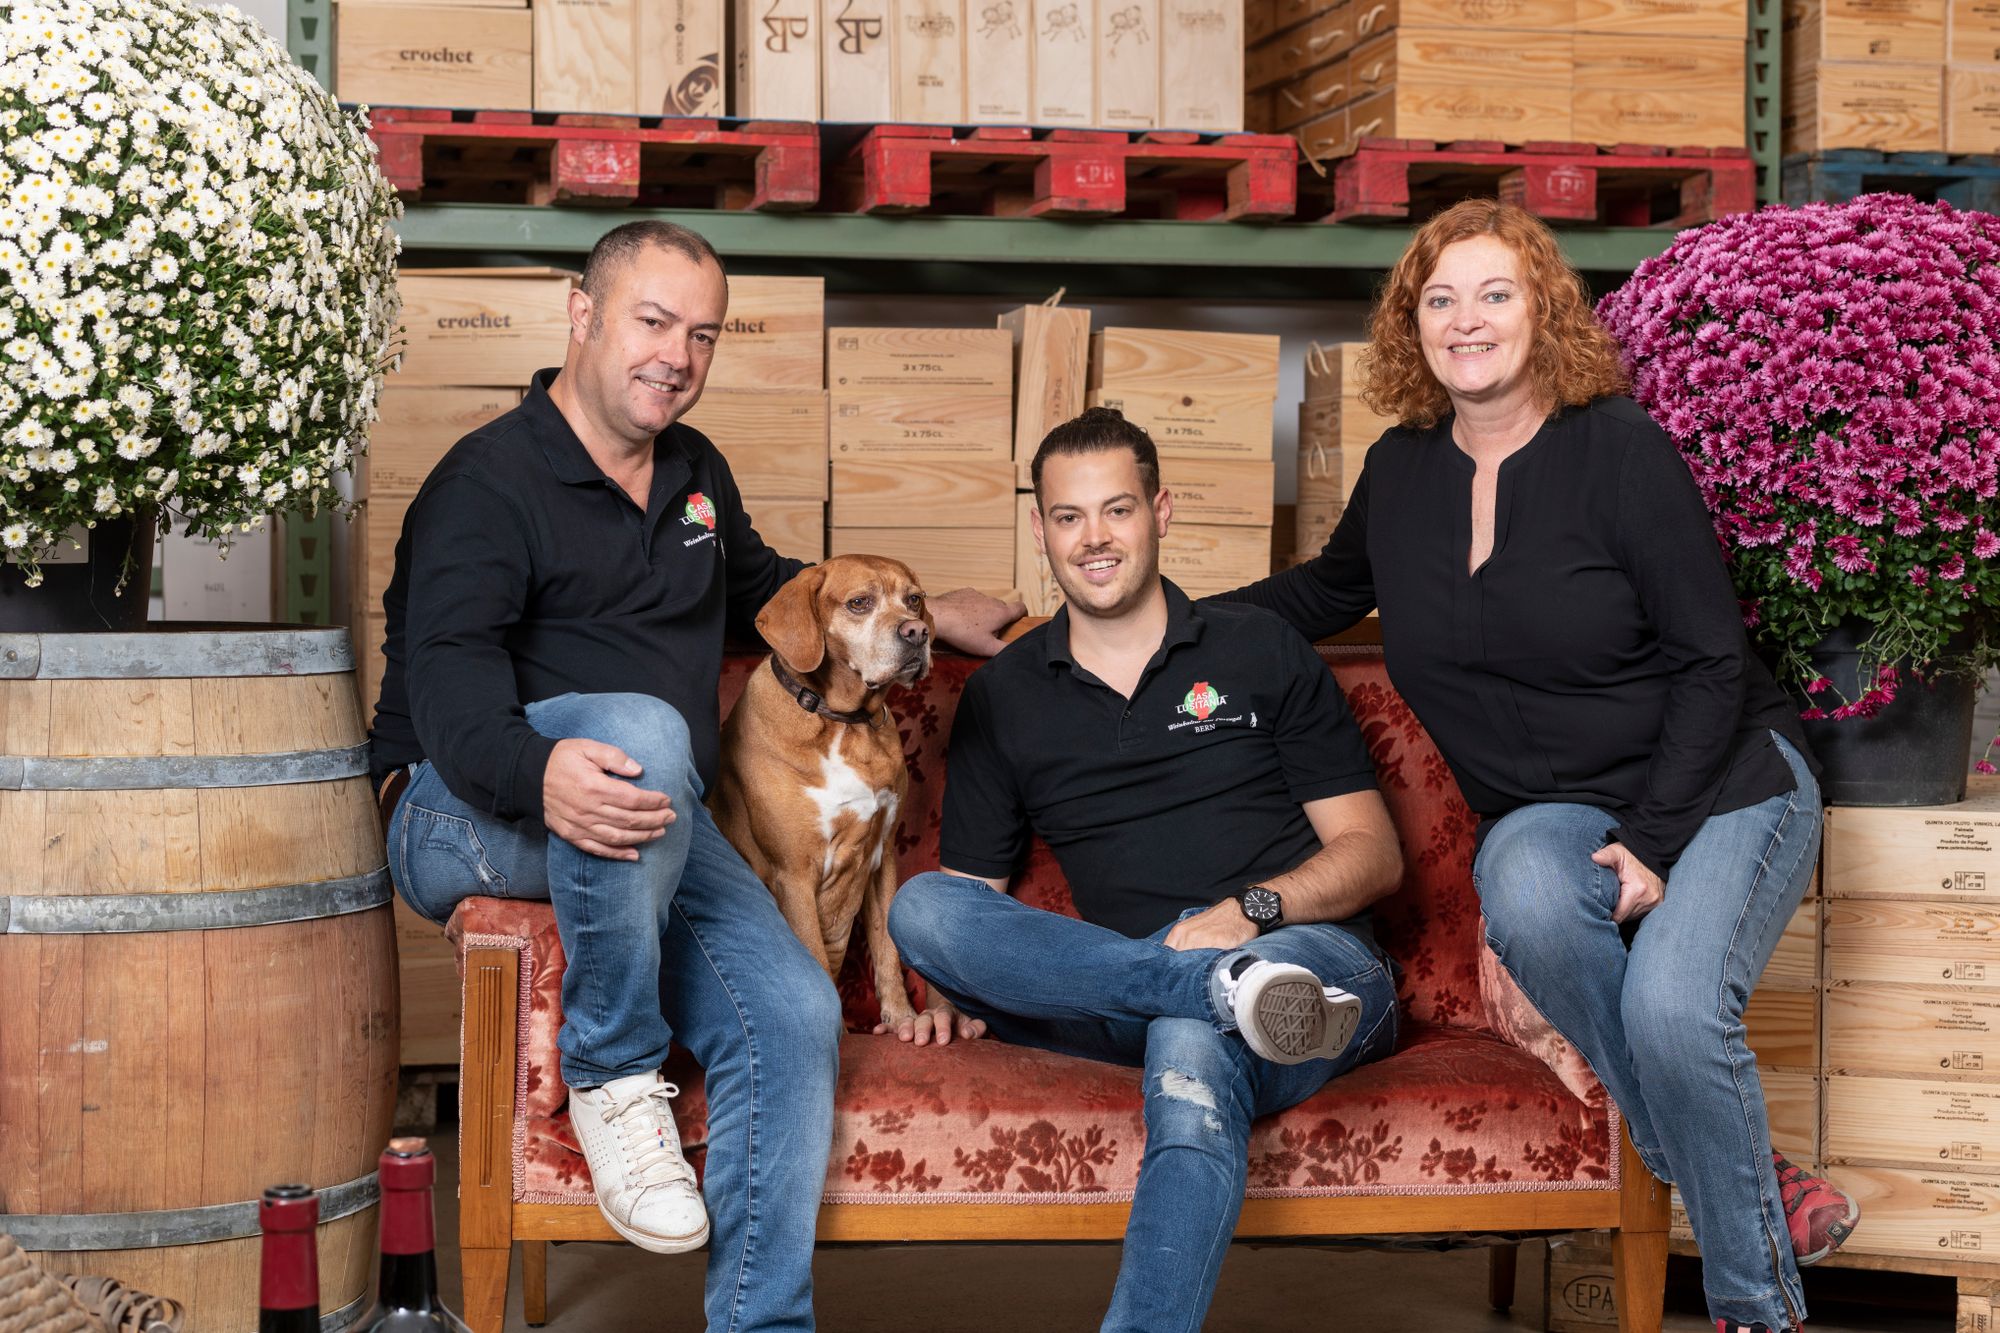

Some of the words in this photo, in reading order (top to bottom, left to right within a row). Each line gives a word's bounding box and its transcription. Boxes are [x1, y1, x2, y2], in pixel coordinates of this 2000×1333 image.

[400, 47, 474, 63] crochet
[437, 312, 512, 328] crochet
[724, 317, 766, 334] chet
[903, 364, 910, 372] 3
[1187, 690, 1214, 702] CASA
[1175, 695, 1228, 714] LUSITANIA
[1194, 723, 1216, 733] BERN
[1576, 1283, 1614, 1310] EPA
